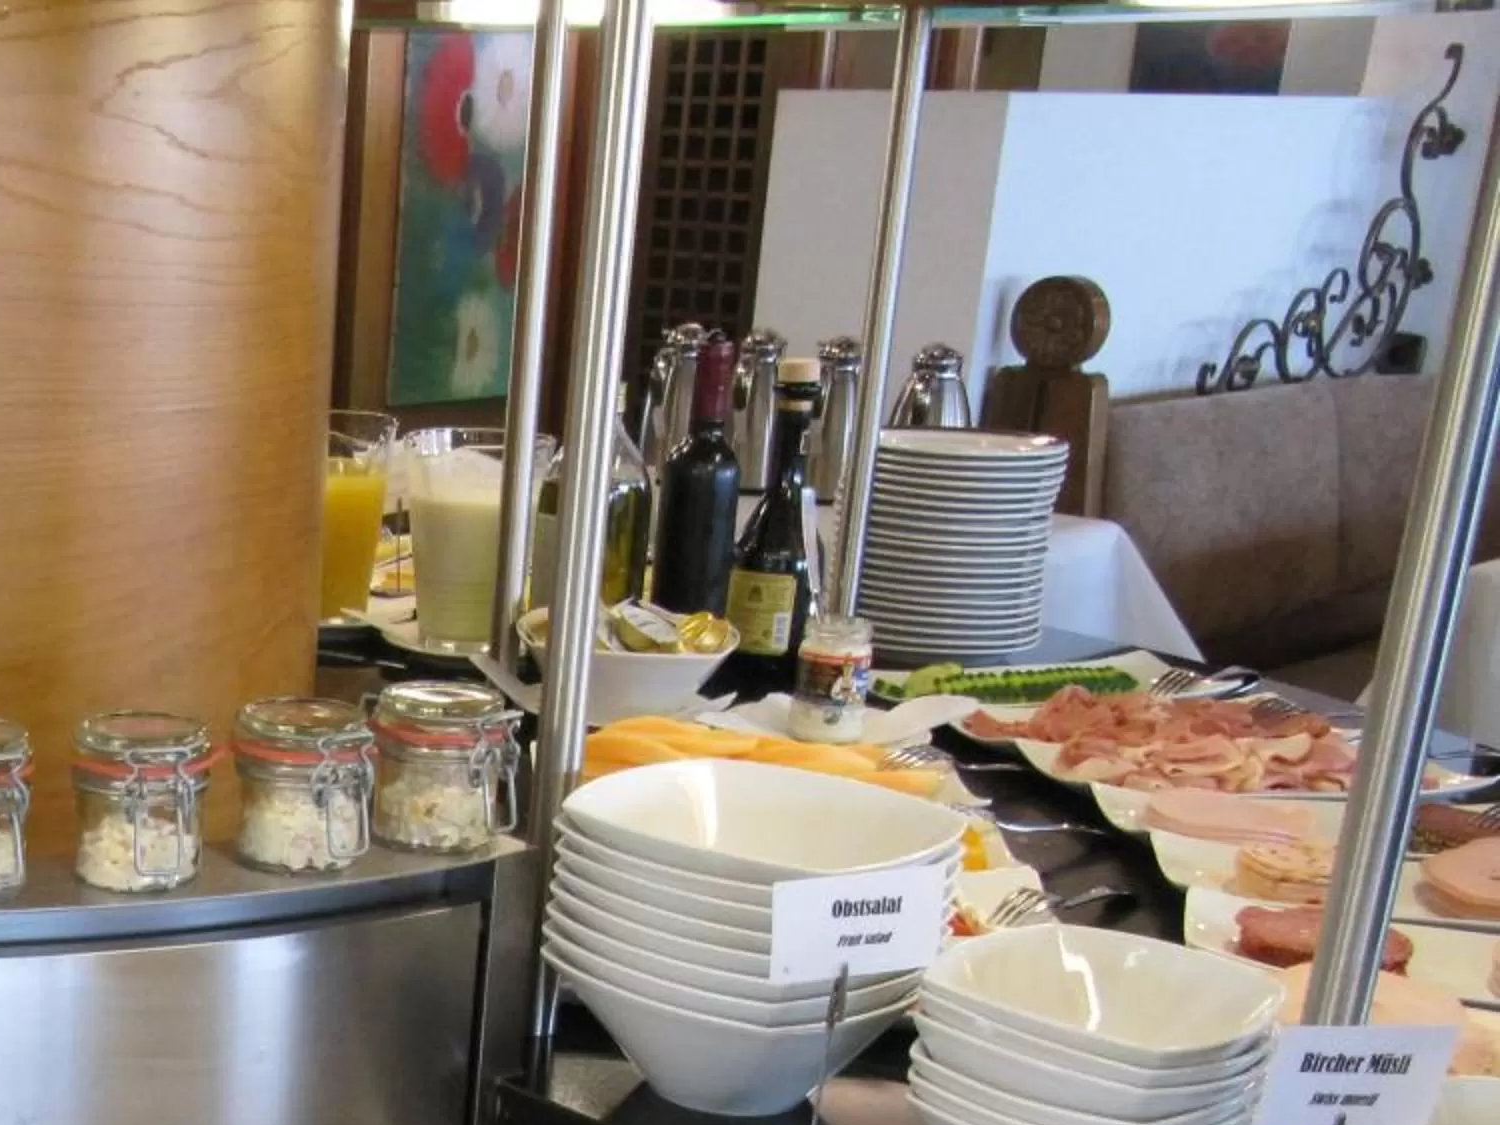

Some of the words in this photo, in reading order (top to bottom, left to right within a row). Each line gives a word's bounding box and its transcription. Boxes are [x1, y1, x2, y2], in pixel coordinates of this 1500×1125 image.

[831, 896, 903, 919] Obstsalat
[1299, 1052, 1366, 1074] Bircher
[1365, 1053, 1413, 1075] Müsli
